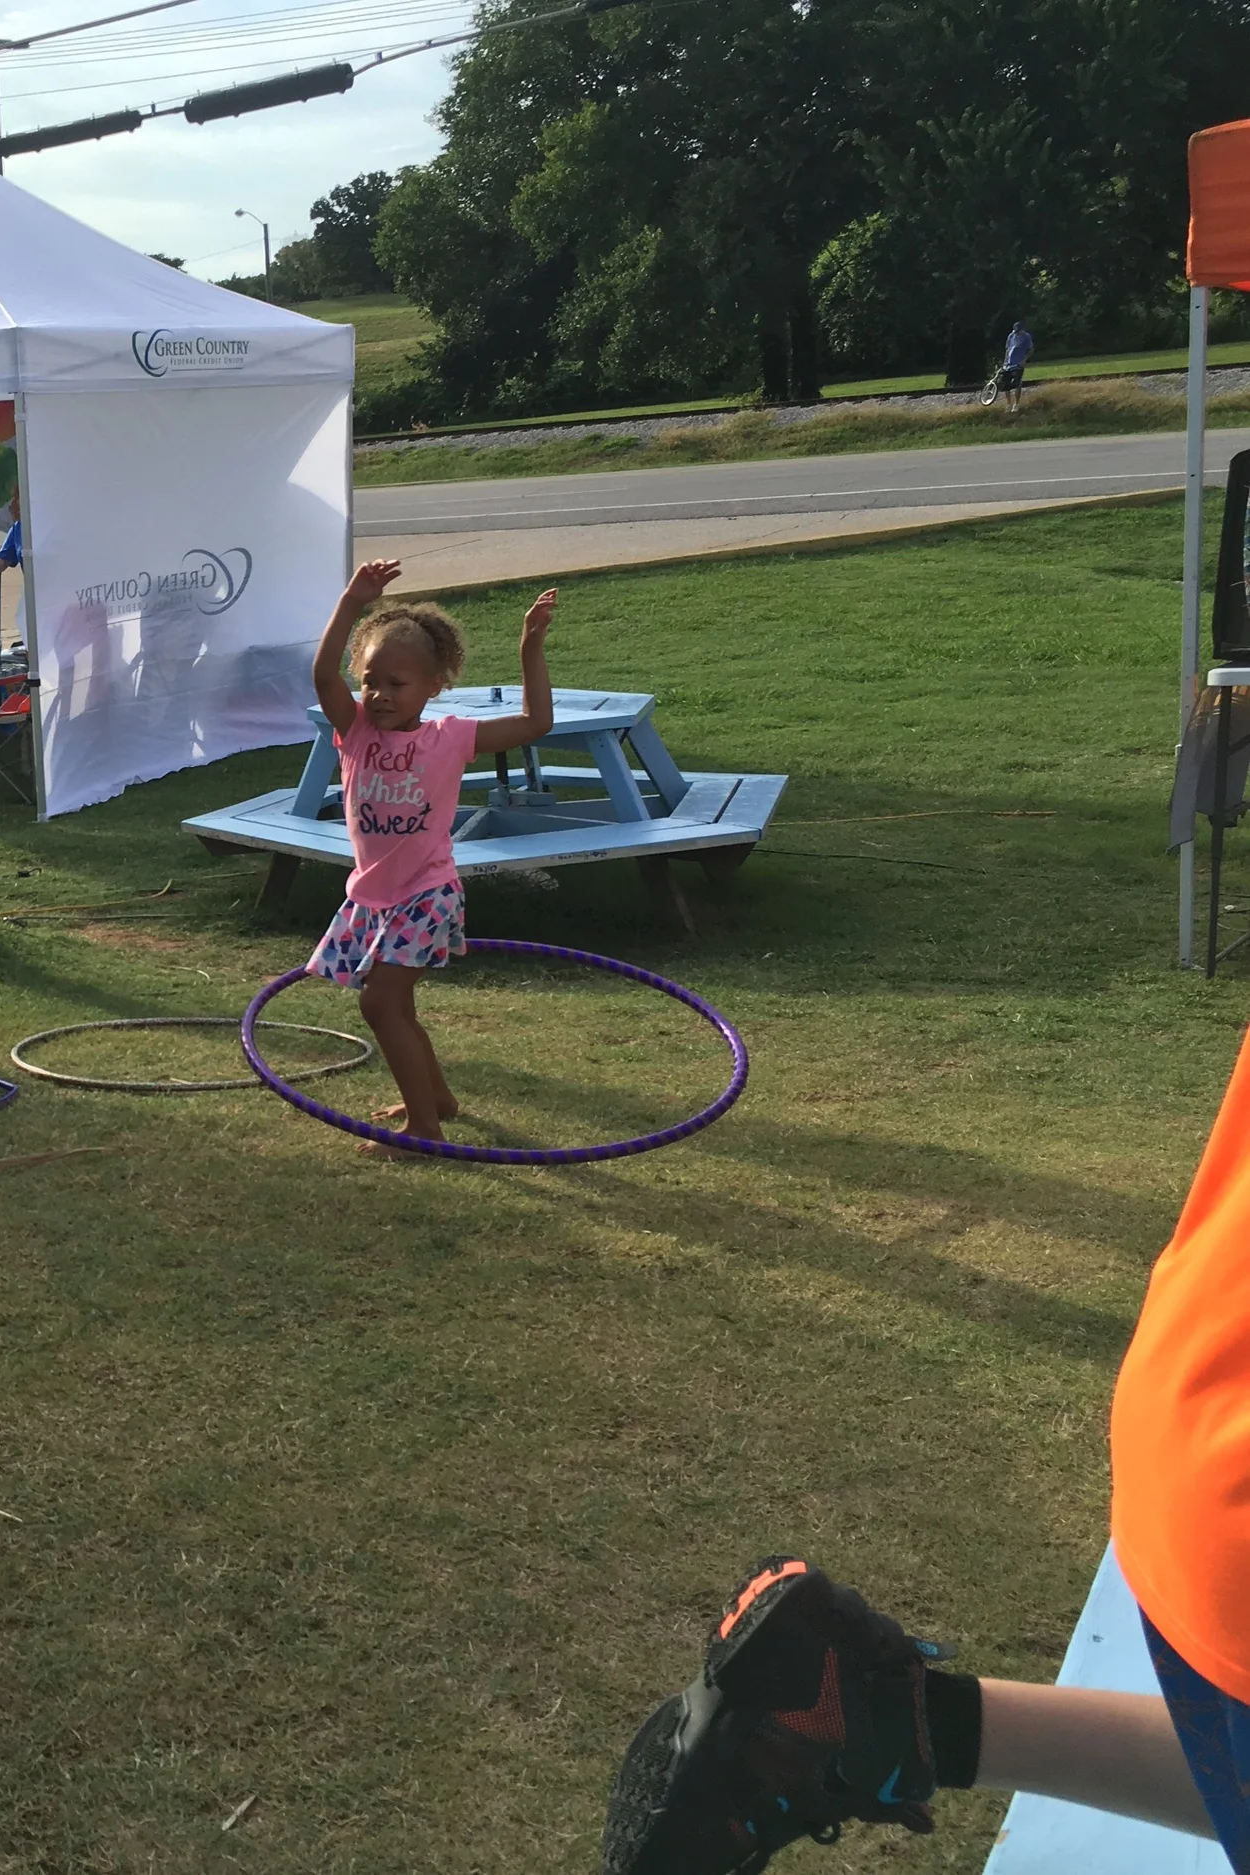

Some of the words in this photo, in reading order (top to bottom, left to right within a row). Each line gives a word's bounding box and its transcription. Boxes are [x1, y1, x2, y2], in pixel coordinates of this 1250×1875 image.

[154, 338, 193, 357] GREEN
[196, 337, 250, 355] COUNTRY
[364, 741, 416, 772] Red
[357, 772, 425, 807] White
[359, 802, 433, 836] Sweet
